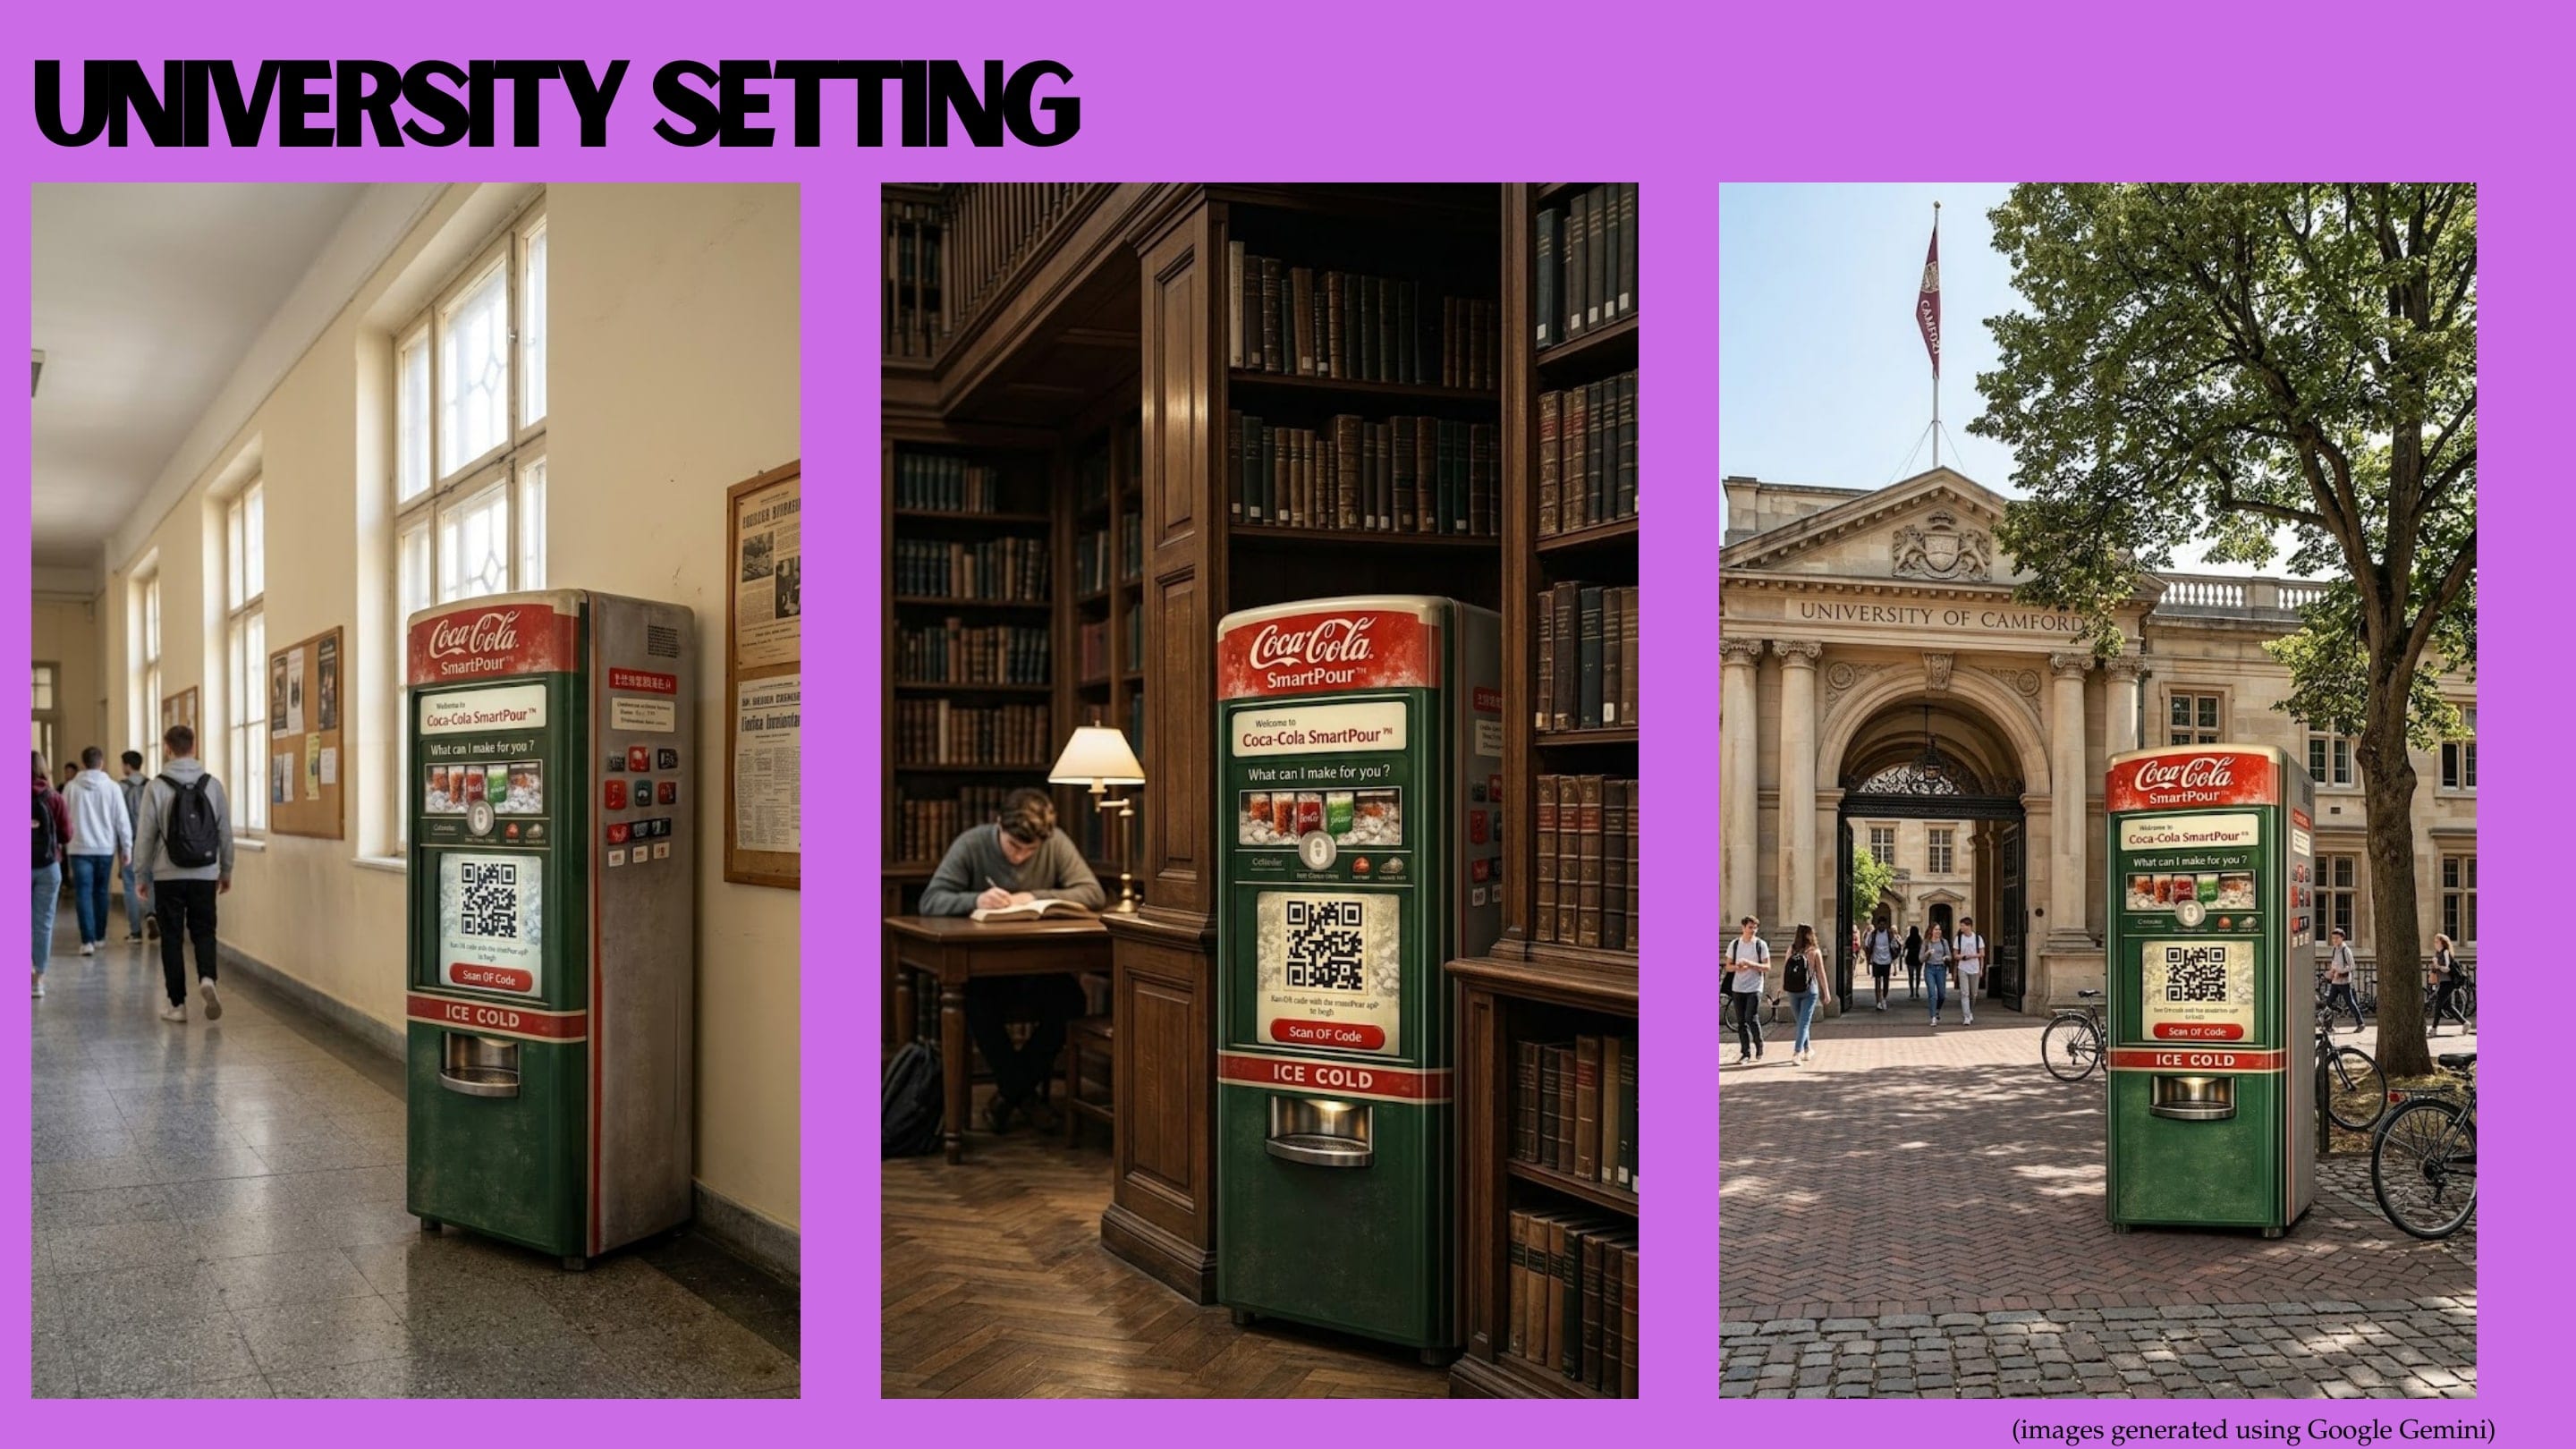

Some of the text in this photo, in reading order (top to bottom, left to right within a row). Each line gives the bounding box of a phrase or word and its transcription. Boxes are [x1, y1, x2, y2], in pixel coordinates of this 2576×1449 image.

[1801, 602, 2085, 632] UNIVERSITY OF CAMFORD
[429, 610, 521, 659] Coca-Cola
[1250, 616, 1377, 670] Coca-Cola
[427, 711, 471, 726] Coca-Cola
[1242, 730, 1305, 747] Coca-Cola
[430, 743, 451, 756] What
[453, 745, 466, 755] can
[472, 741, 495, 754] make
[496, 741, 509, 752] for
[511, 743, 527, 755] you
[1248, 767, 1275, 781] What
[1279, 769, 1297, 780] can
[1301, 767, 1304, 779] I
[1308, 766, 1337, 779] make
[1340, 765, 1357, 778] for
[2134, 756, 2236, 792] Coca-Cola
[2129, 833, 2180, 844] Coca-Cola
[2133, 858, 2157, 867] What
[2158, 858, 2174, 867] can
[2182, 856, 2206, 866] make
[2207, 855, 2220, 865] for
[2222, 856, 2240, 867] you
[496, 974, 516, 986] Code
[445, 1004, 521, 1028] ICE COLD
[1289, 1026, 1314, 1038] Scan
[1335, 1030, 1362, 1042] Code
[2204, 1028, 2227, 1037] Code
[2156, 1054, 2235, 1067] ICE COLD
[1273, 1063, 1373, 1089] ICE COLD
